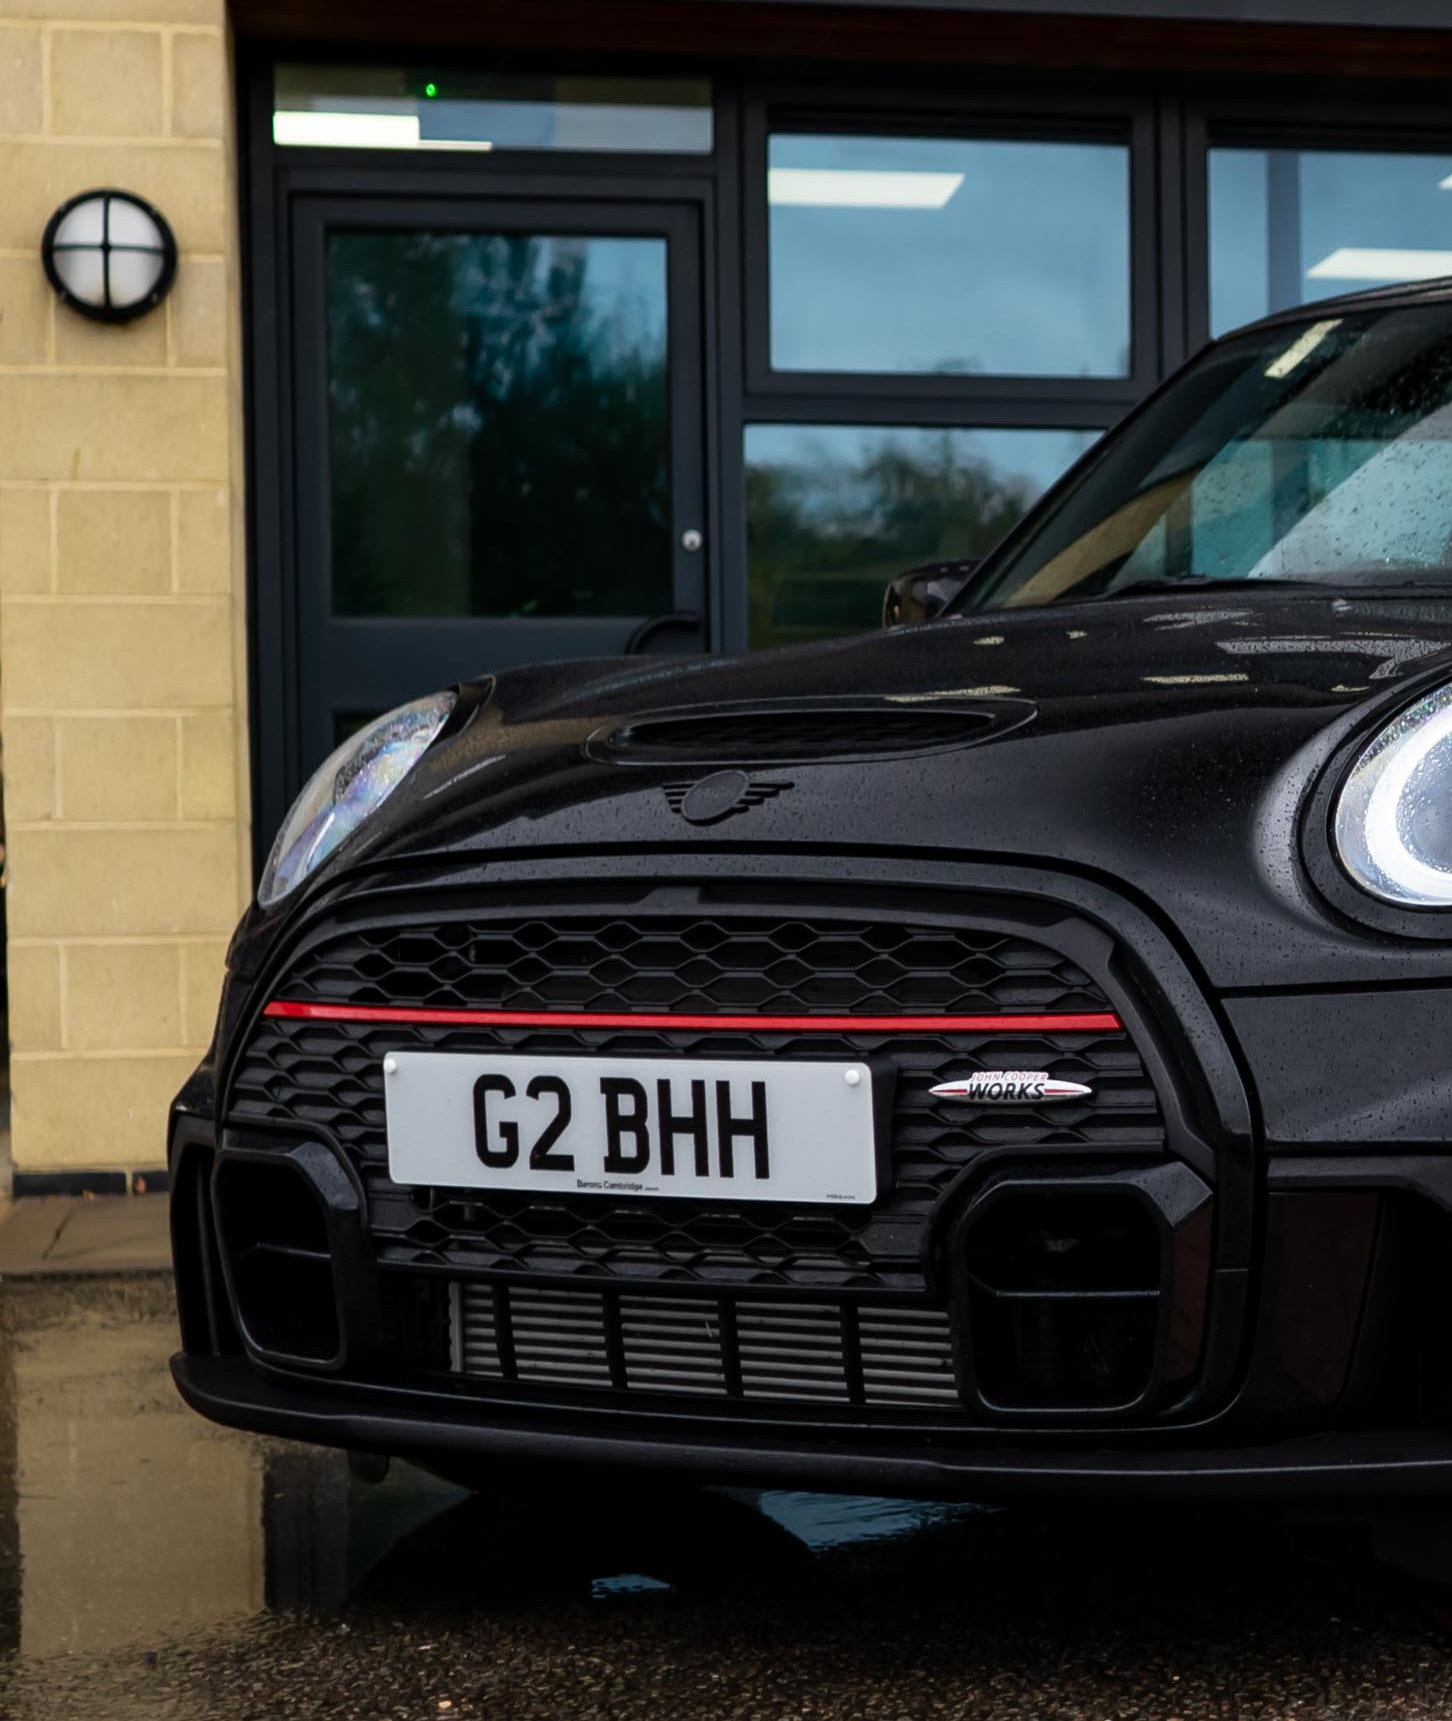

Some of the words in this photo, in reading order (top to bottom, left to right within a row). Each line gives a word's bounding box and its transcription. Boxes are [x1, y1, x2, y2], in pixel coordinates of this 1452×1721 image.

[971, 1072, 1002, 1082] JOHN
[1003, 1071, 1048, 1081] COOPER
[967, 1082, 1046, 1100] WORKS
[472, 1073, 575, 1172] G2
[599, 1076, 770, 1180] BHH
[603, 1180, 643, 1192] Cambridge
